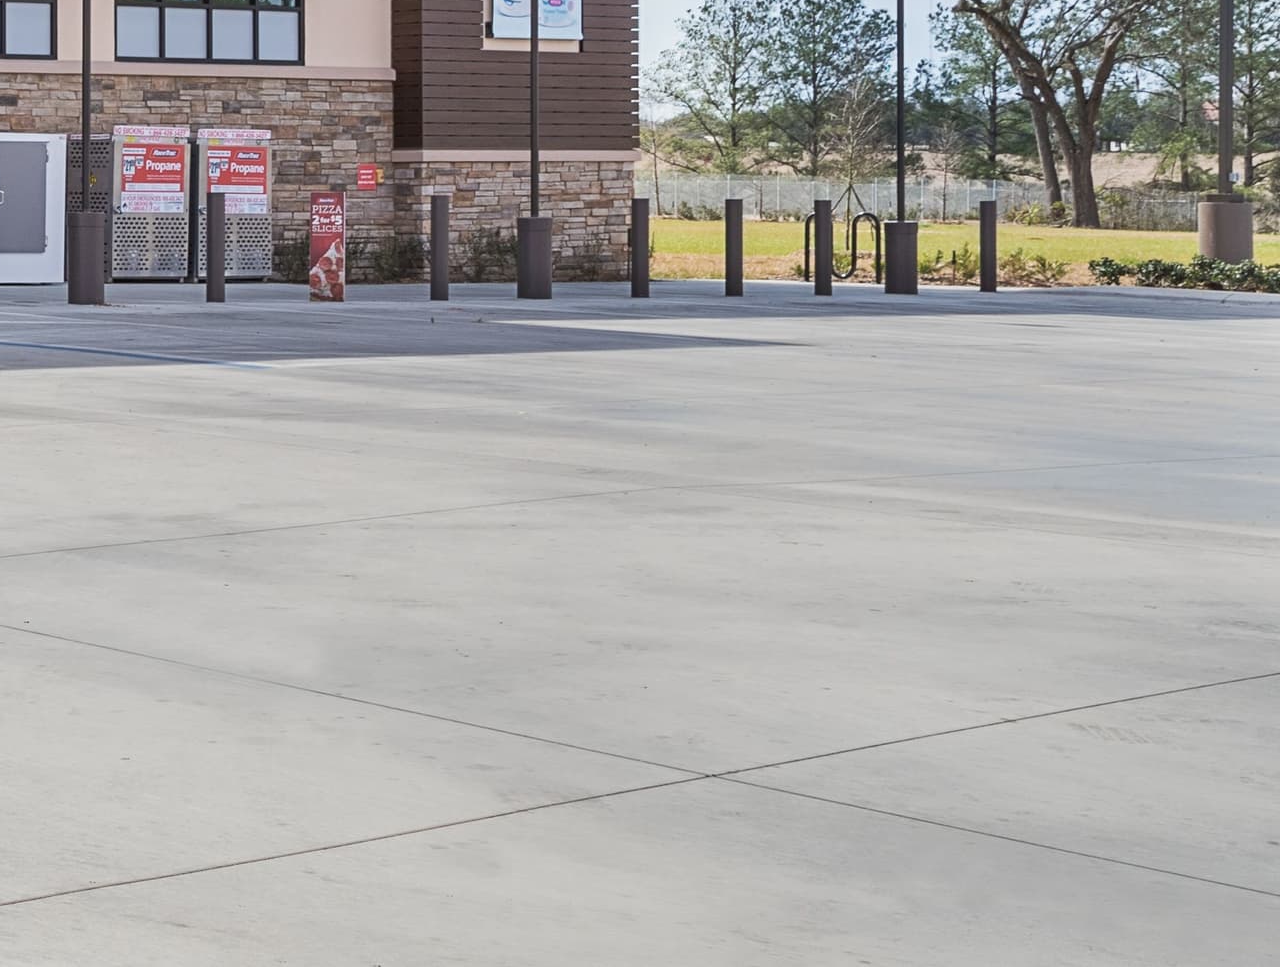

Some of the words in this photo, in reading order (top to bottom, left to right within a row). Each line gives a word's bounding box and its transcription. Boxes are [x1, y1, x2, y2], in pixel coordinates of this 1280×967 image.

[146, 160, 182, 173] Propane
[230, 162, 265, 176] Propane
[312, 205, 342, 214] PIZZA
[312, 215, 320, 224] 2
[320, 216, 330, 224] for
[330, 215, 342, 225] $5
[312, 225, 342, 233] SLICES
